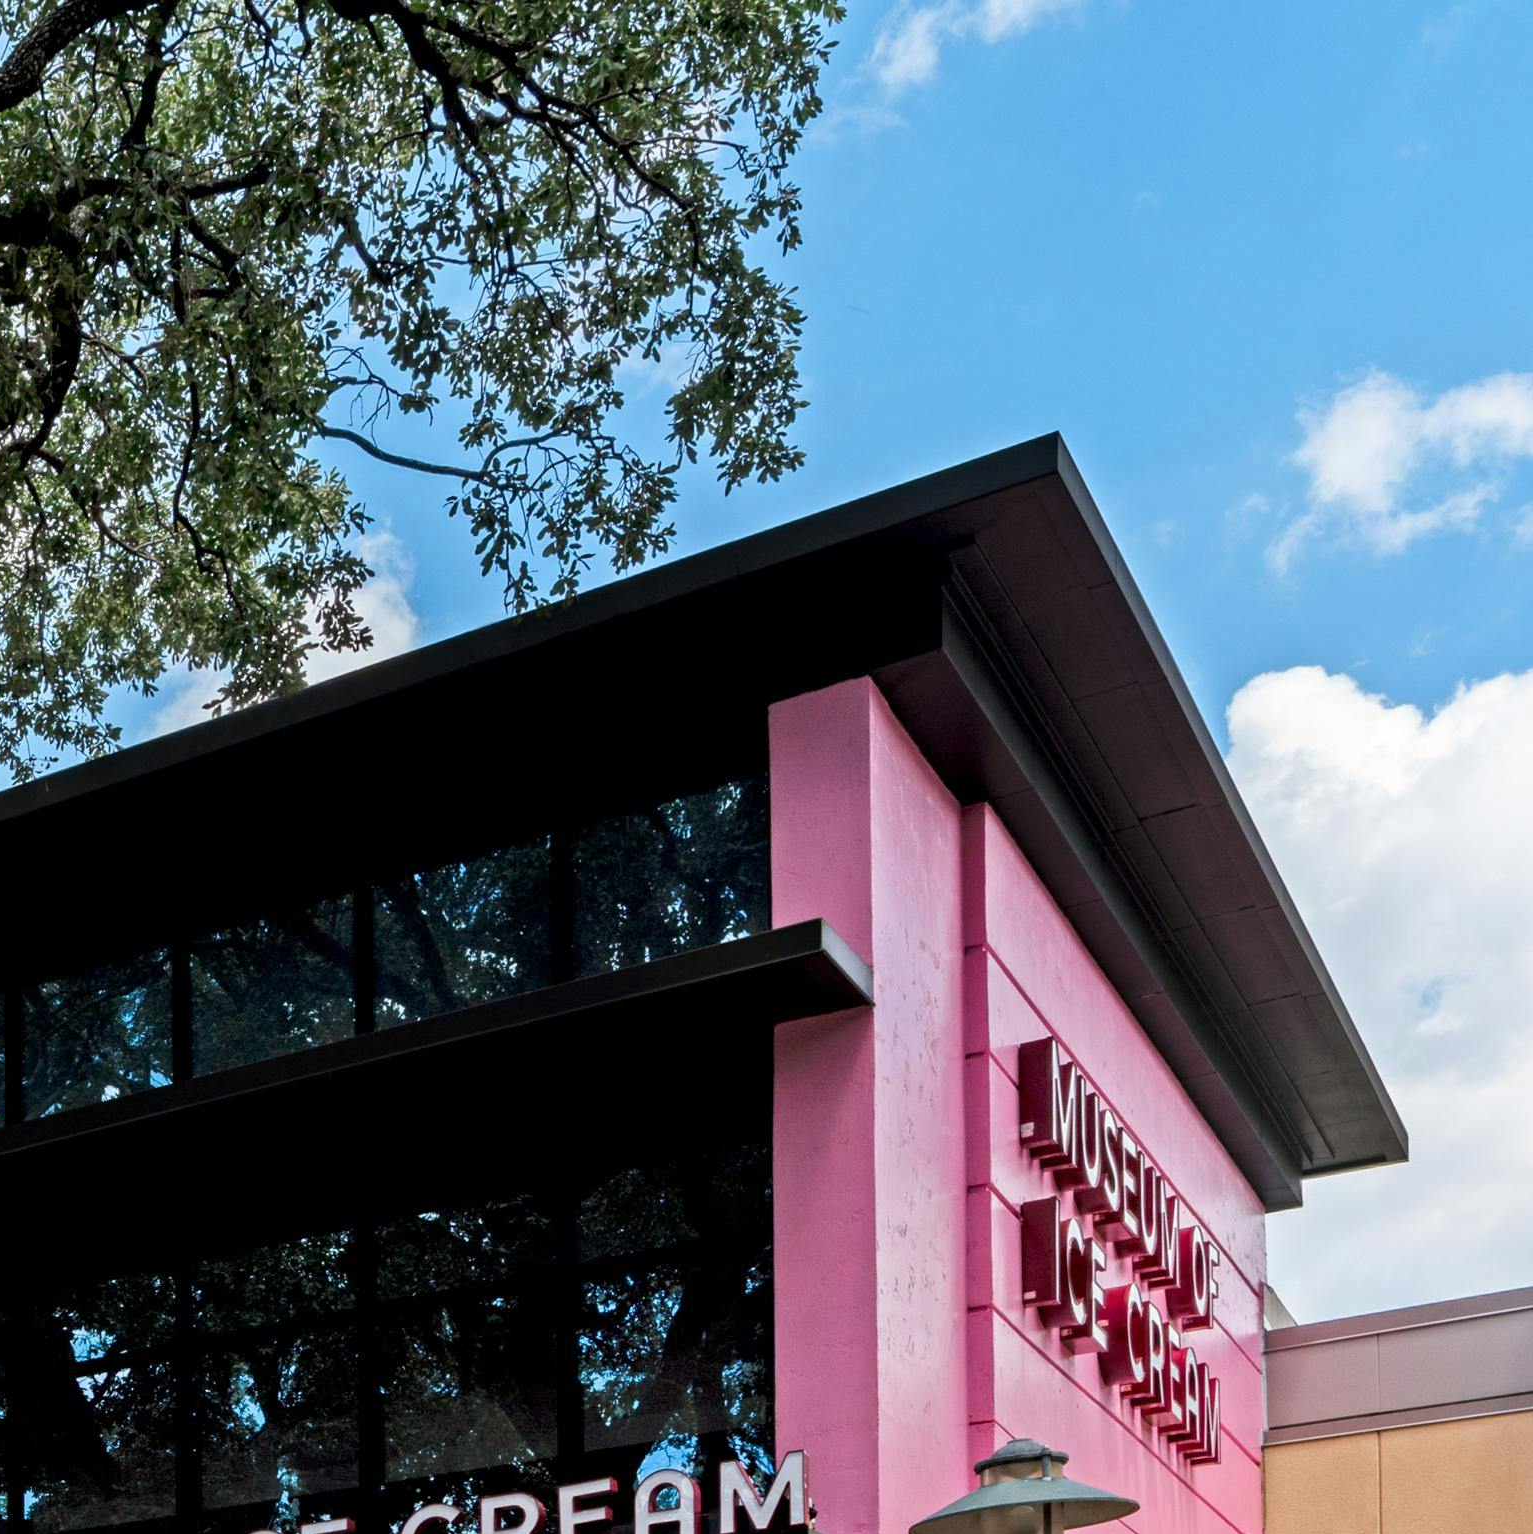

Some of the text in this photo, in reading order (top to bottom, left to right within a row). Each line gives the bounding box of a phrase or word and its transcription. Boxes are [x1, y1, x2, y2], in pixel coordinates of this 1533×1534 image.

[1041, 1037, 1220, 1330] MUSEUM OF
[1038, 1195, 1222, 1465] ICE CREAM
